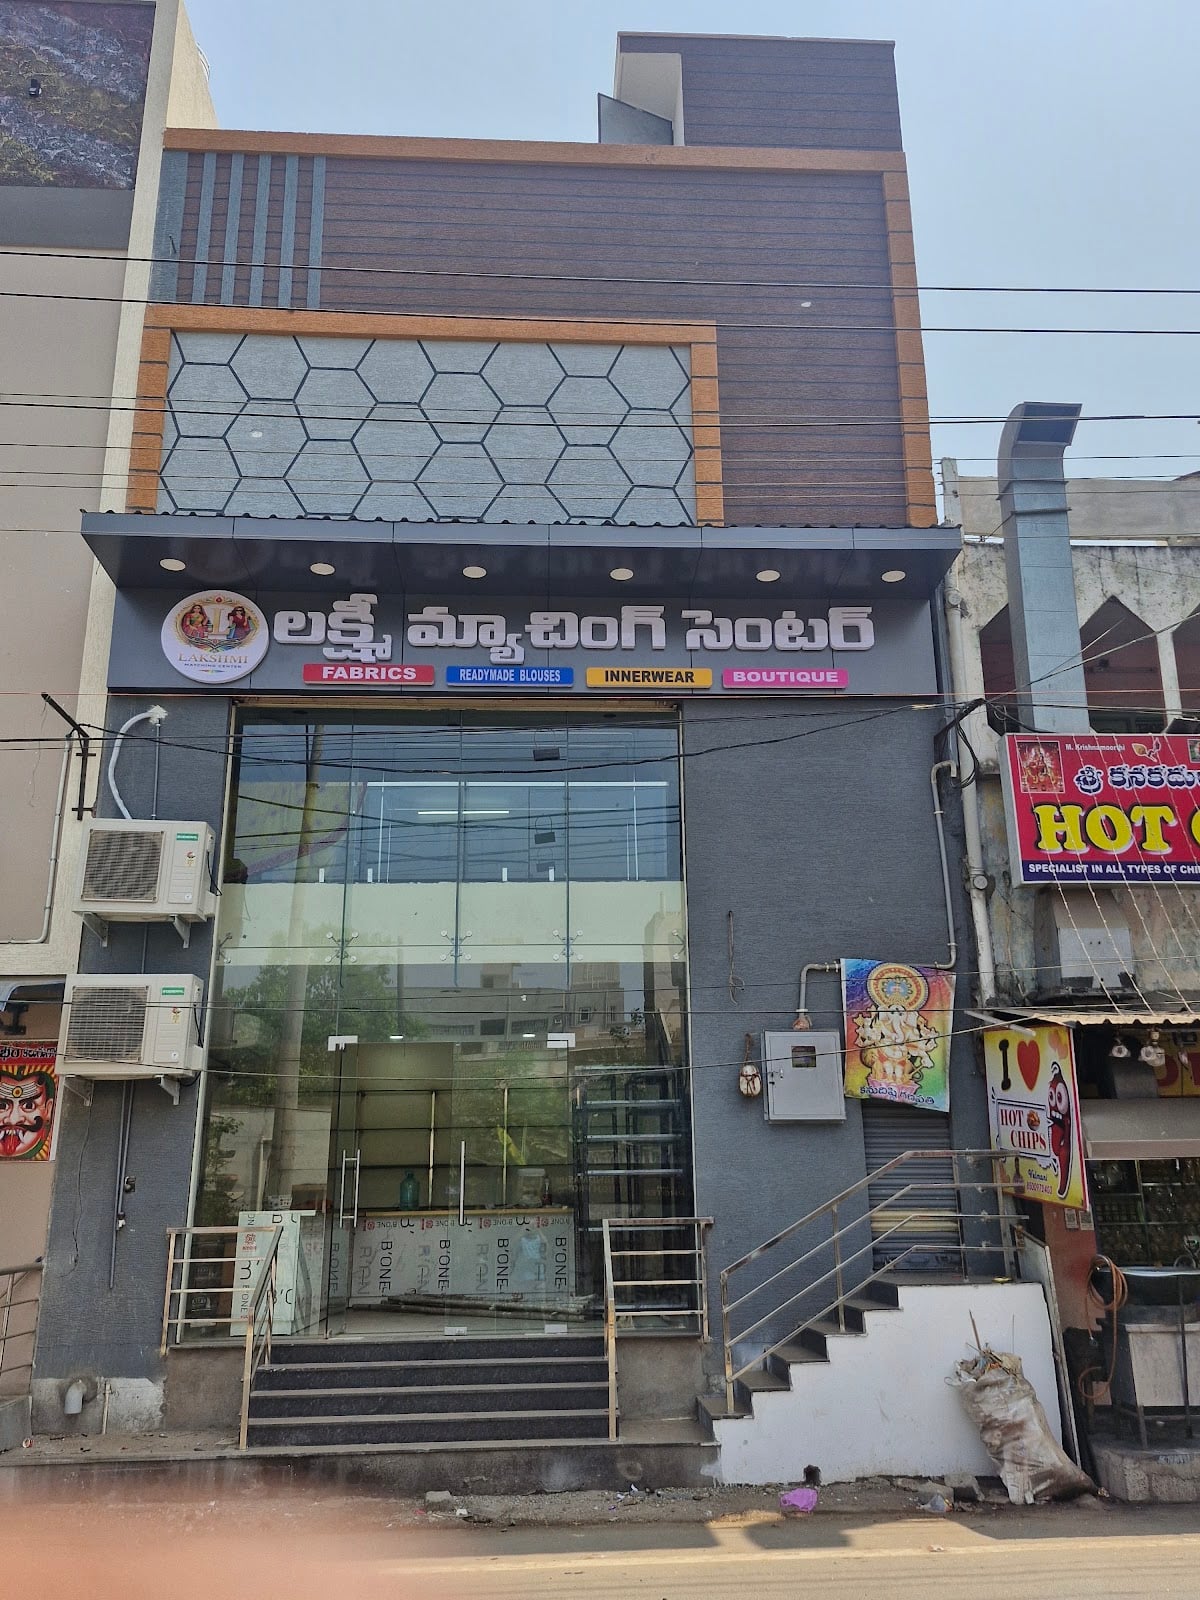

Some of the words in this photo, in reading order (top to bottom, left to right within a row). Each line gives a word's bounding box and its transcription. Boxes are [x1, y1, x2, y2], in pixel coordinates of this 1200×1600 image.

[273, 593, 392, 664] లక్ష్మీ
[681, 605, 875, 651] సెంటర్
[178, 652, 249, 664] LAKSHMI
[322, 667, 417, 681] FABRICS
[459, 668, 515, 682] READYMADE
[519, 669, 561, 682] BLOUSES
[604, 670, 695, 684] INNERWEAR
[733, 671, 839, 684] BOUTIQUE
[1033, 804, 1177, 854] HOT
[1028, 863, 1089, 874] SPECIALIST
[1091, 864, 1103, 874] IN
[1105, 864, 1125, 874] ALL
[1127, 864, 1160, 874] TYPES
[1163, 864, 1177, 874] OF
[998, 1038, 1012, 1091] I
[1000, 1108, 1024, 1127] HOT
[1010, 1130, 1047, 1151] CHIPS
[379, 1240, 393, 1291] B'ONE
[437, 1239, 451, 1289] B'ONE
[496, 1238, 509, 1288] B'ONE
[554, 1237, 567, 1288] B'ONE
